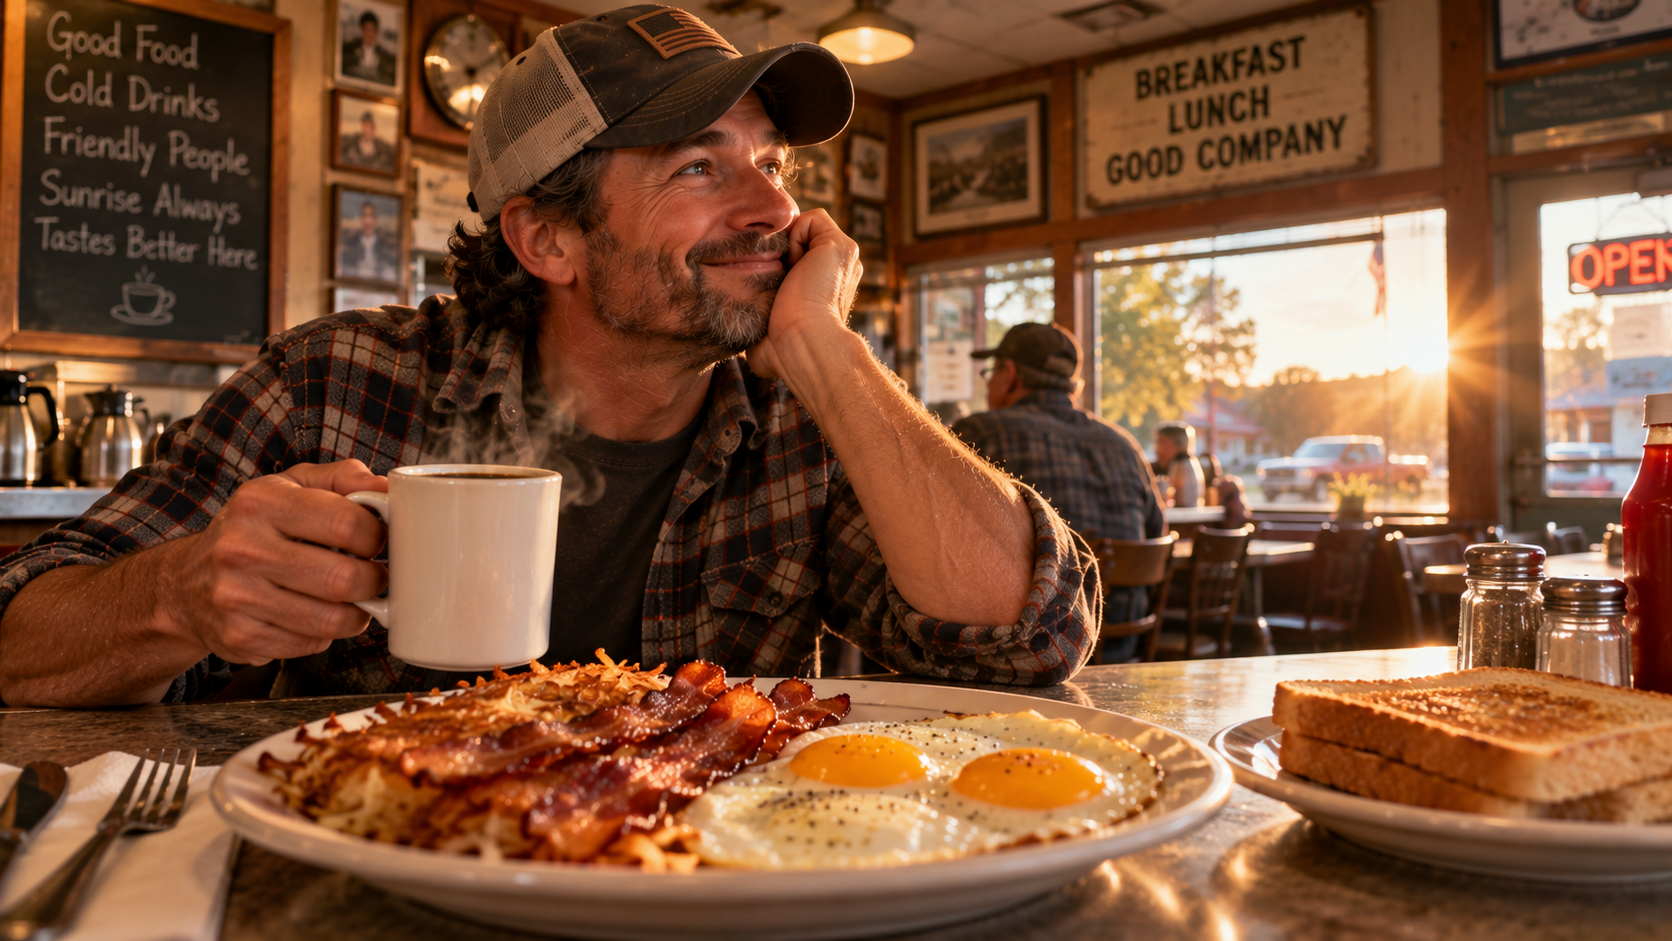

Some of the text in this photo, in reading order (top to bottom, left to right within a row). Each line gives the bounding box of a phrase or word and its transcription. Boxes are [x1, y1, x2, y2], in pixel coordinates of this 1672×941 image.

[46, 10, 200, 70] Good Food
[1134, 34, 1306, 101] BREAKFAST
[44, 63, 220, 122] Cold Drinks
[1168, 84, 1270, 135] LUNCH
[43, 115, 250, 183] Friendly People
[1106, 114, 1347, 185] GOOD COMPANY
[39, 168, 241, 234] Sunrise Always
[33, 215, 259, 270] Tastes Better Here
